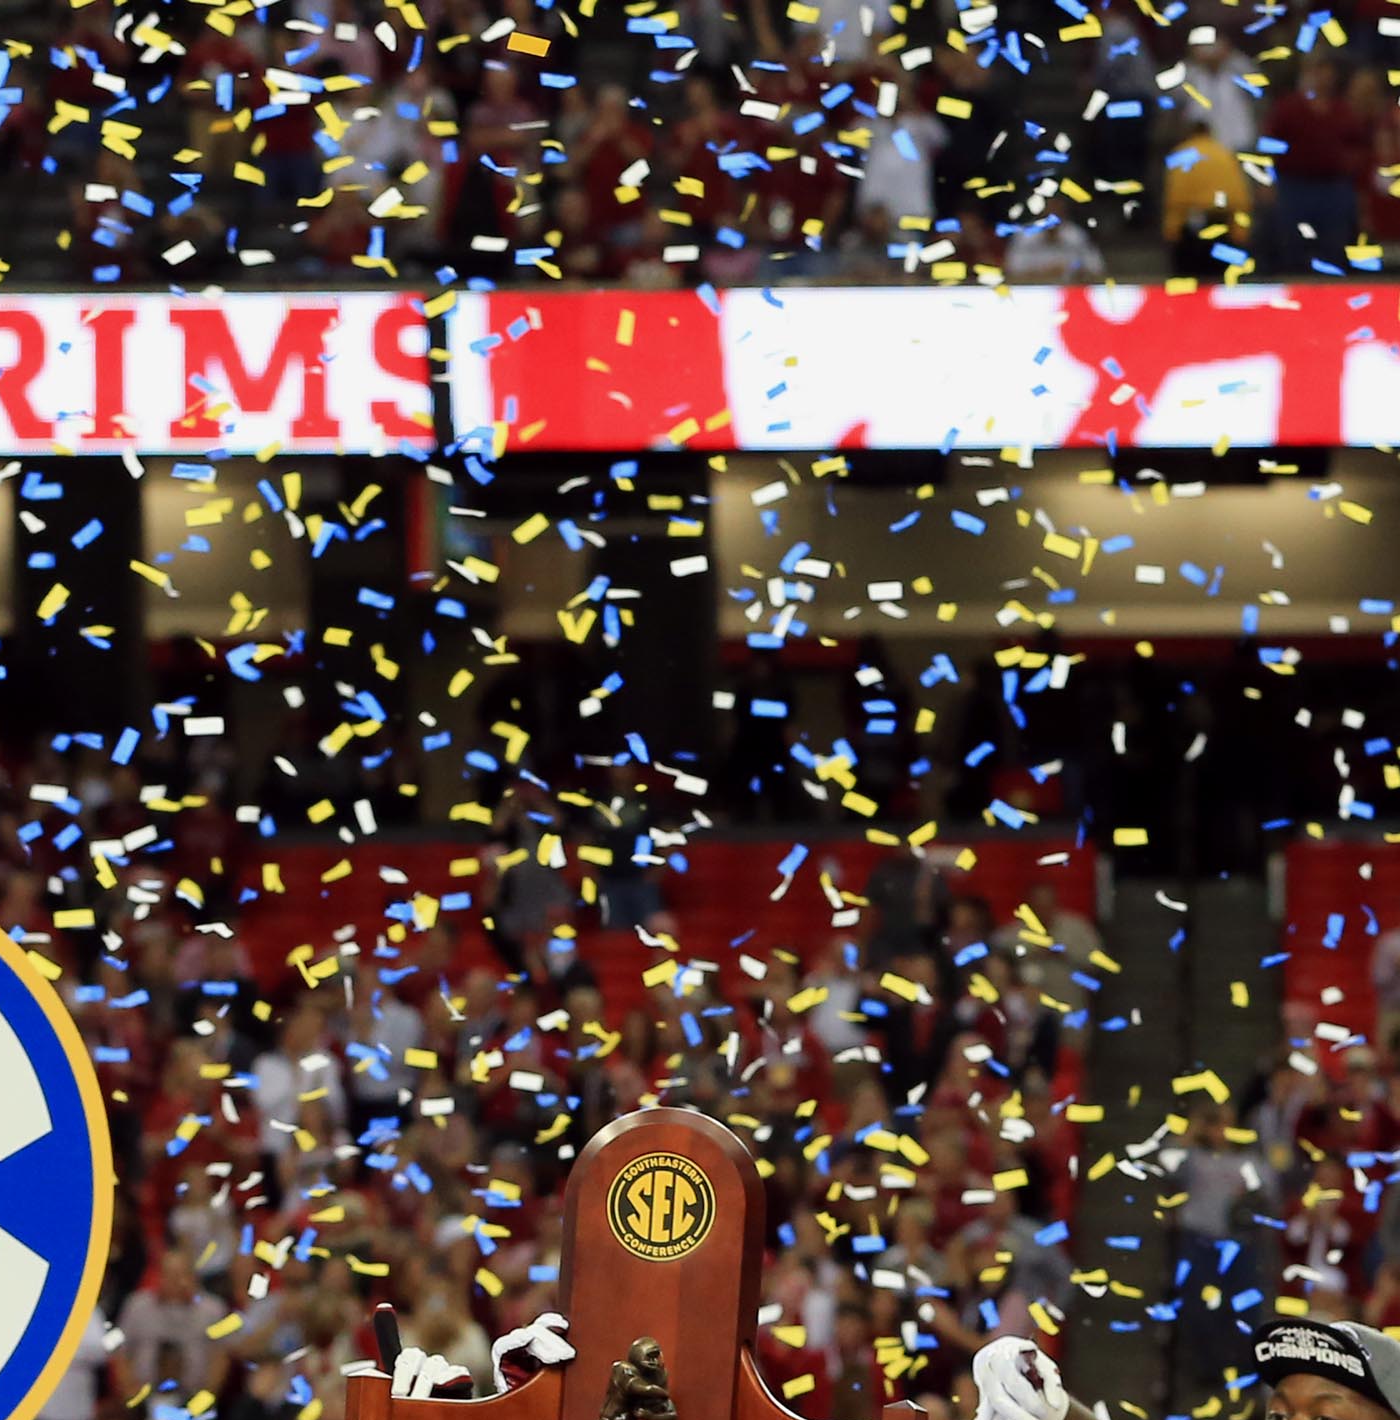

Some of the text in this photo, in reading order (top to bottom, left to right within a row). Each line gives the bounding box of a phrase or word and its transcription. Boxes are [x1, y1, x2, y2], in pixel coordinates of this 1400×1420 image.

[624, 1157, 703, 1184] SOUTHEASTERN
[627, 1170, 697, 1242] SEC
[624, 1234, 695, 1256] CONFERENCE
[1256, 1341, 1365, 1377] CHAMPIONS
